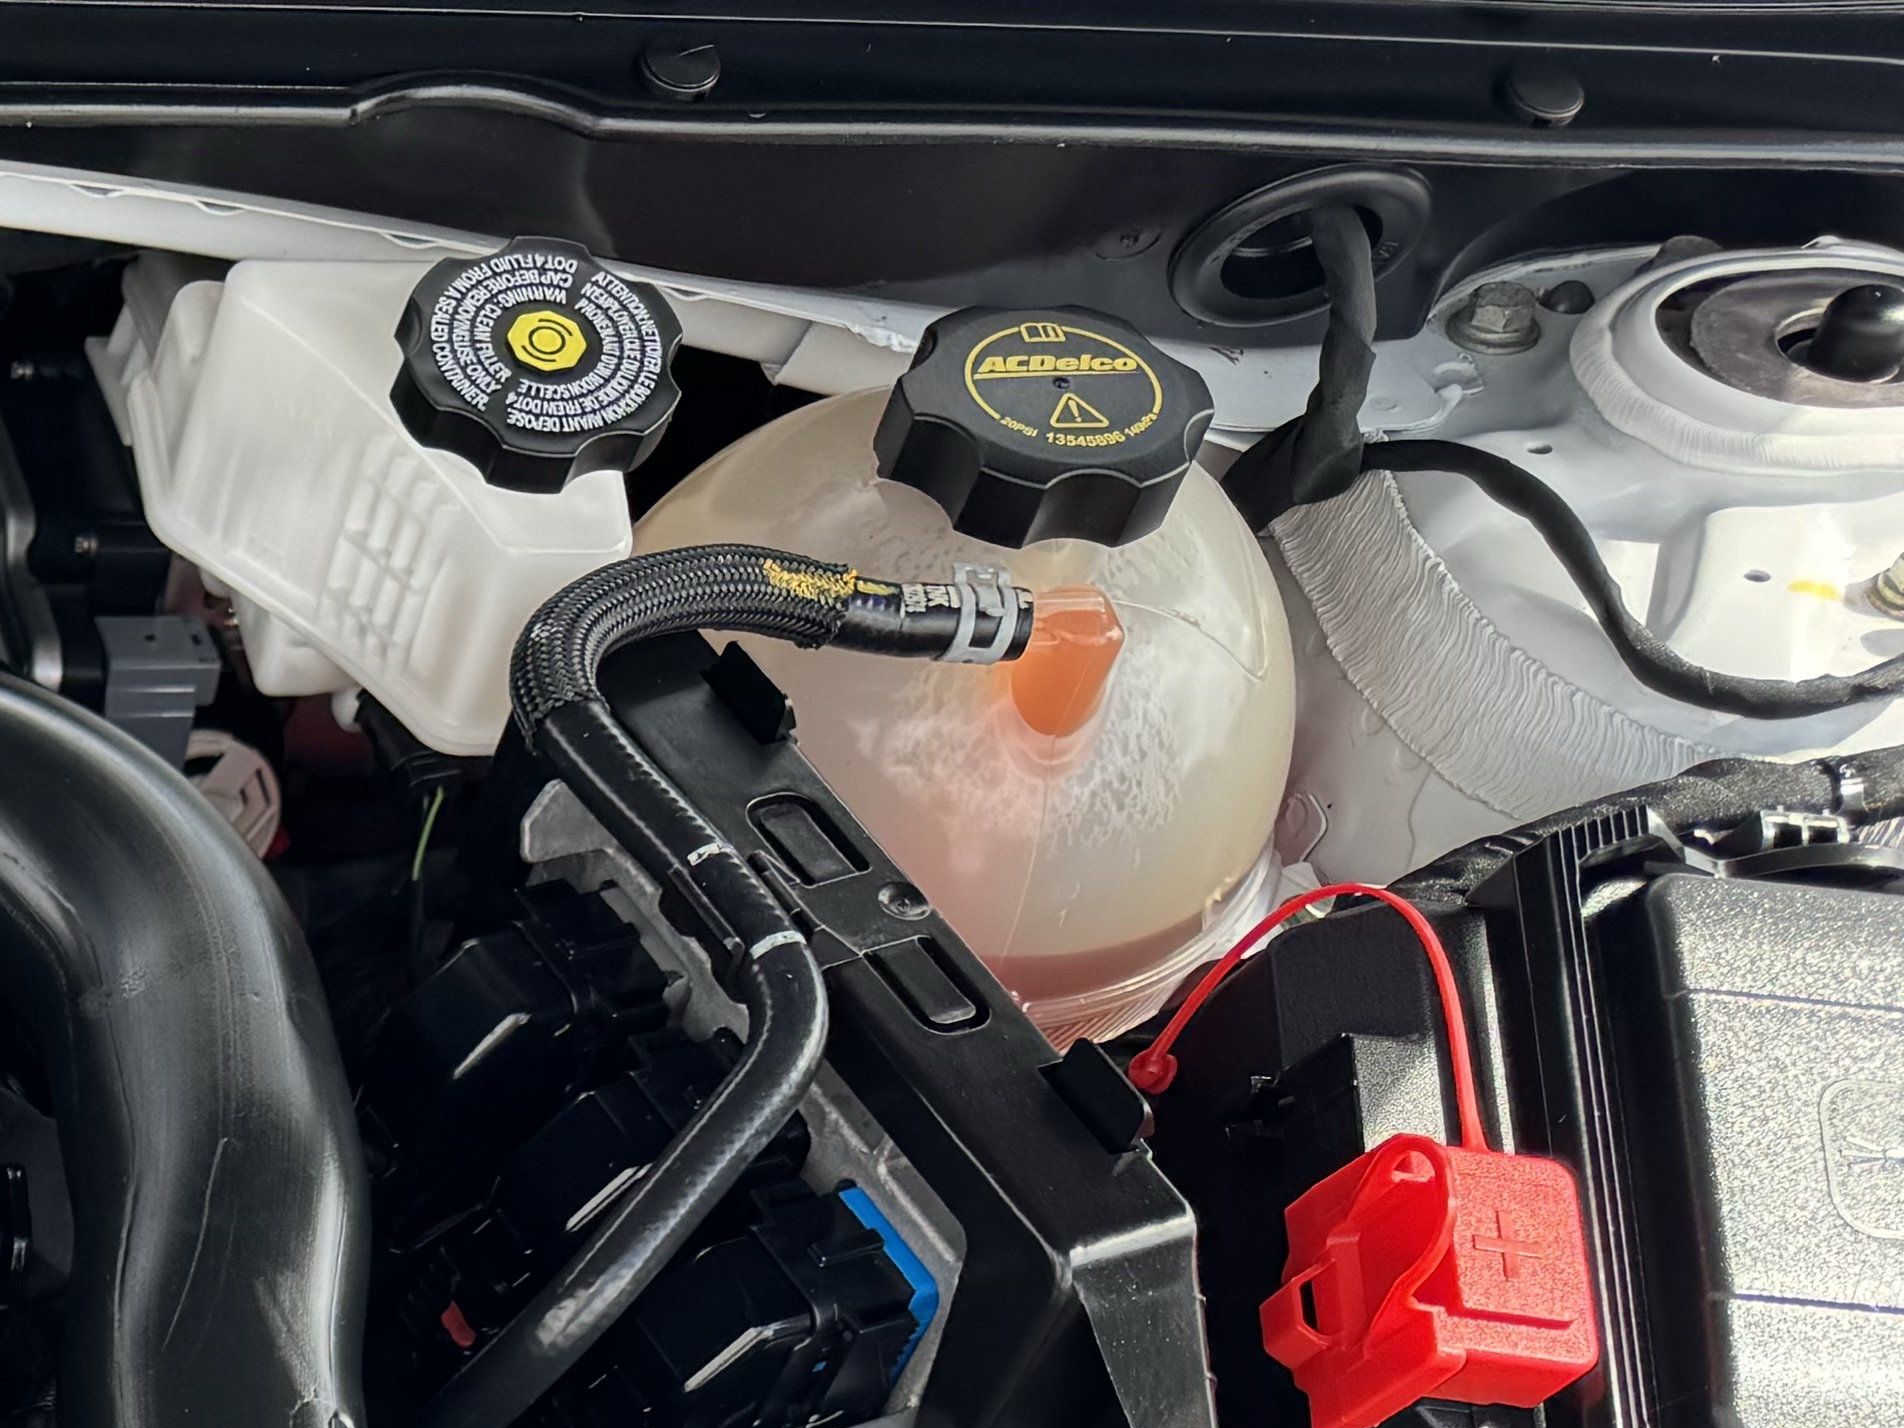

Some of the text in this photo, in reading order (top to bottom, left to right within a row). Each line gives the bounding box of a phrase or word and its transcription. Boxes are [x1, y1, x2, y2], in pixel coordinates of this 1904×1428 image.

[490, 254, 533, 272] FLUID
[544, 255, 578, 274] DOT
[452, 263, 492, 292] FROM
[483, 269, 540, 294] BEFORE
[541, 271, 573, 288] CAP
[431, 296, 457, 341] SEALED
[977, 354, 1139, 374] ACDelco
